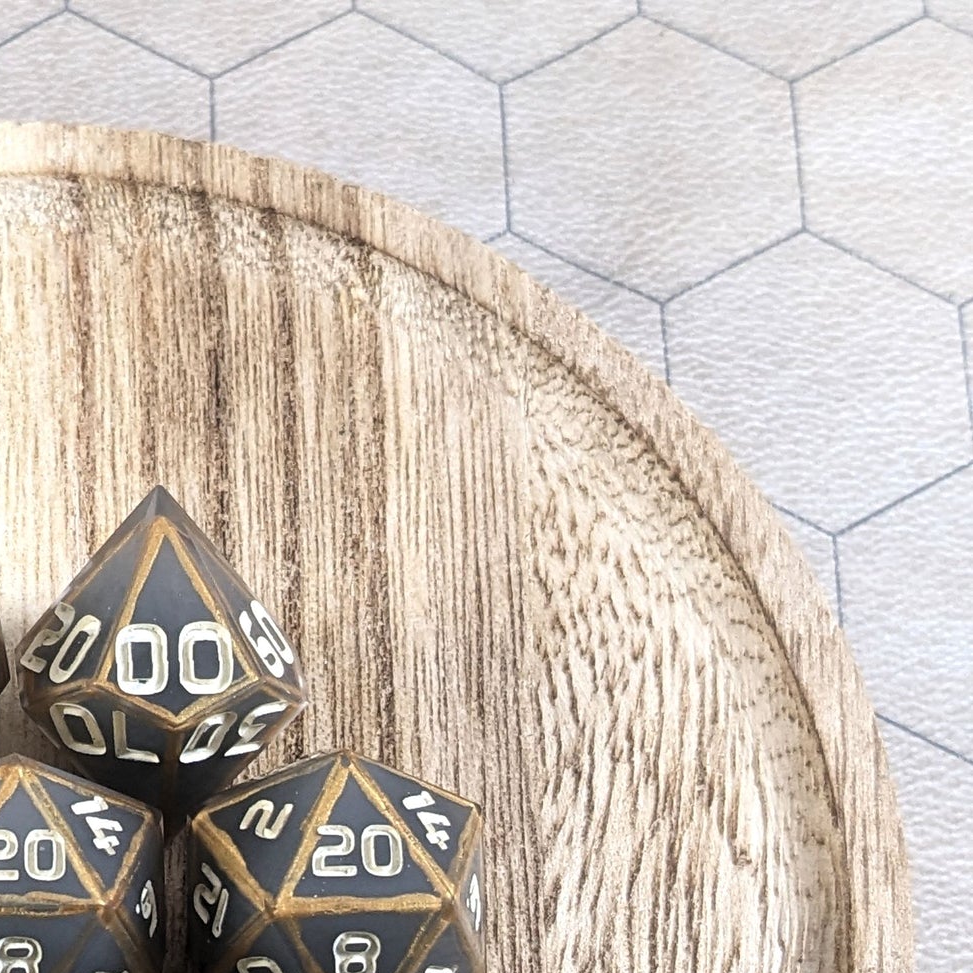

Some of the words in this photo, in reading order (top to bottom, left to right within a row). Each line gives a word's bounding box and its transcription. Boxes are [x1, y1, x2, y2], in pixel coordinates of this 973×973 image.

[19, 601, 101, 684] 20
[115, 620, 234, 696] 00
[238, 600, 294, 678] 60
[70, 795, 123, 856] 14
[239, 799, 294, 840] 2
[402, 790, 451, 850] 14
[311, 824, 404, 877] 20
